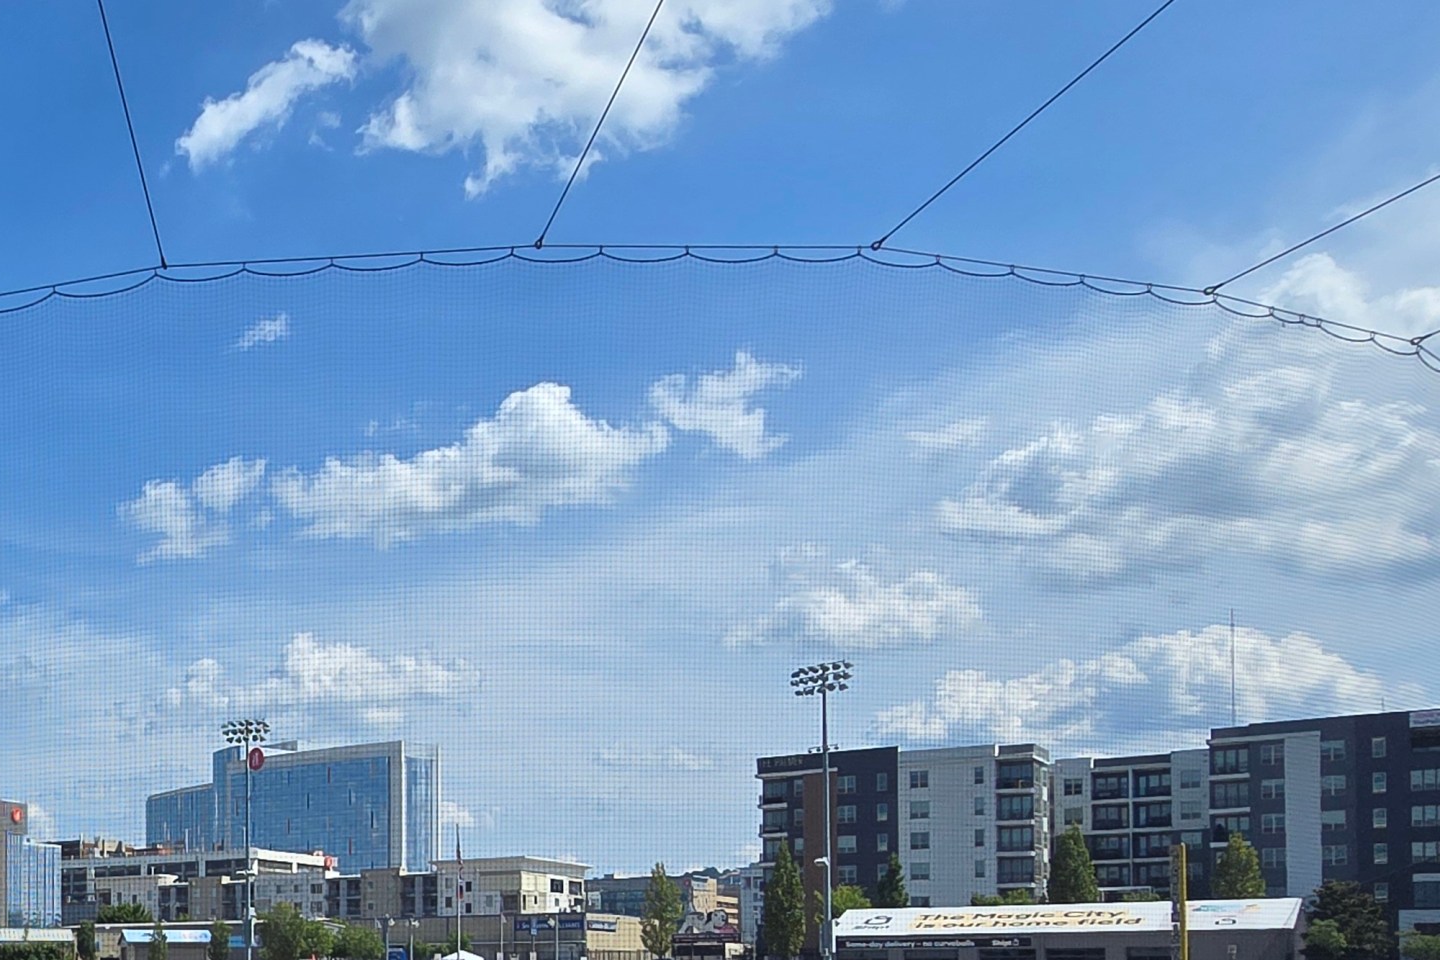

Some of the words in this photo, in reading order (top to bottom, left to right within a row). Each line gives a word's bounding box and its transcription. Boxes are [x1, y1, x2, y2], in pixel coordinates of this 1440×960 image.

[919, 913, 954, 921] The
[972, 910, 1056, 921] Magic
[1063, 909, 1125, 919] City
[914, 920, 935, 929] is
[942, 921, 983, 929] our
[991, 919, 1069, 928] home
[1077, 916, 1143, 926] field
